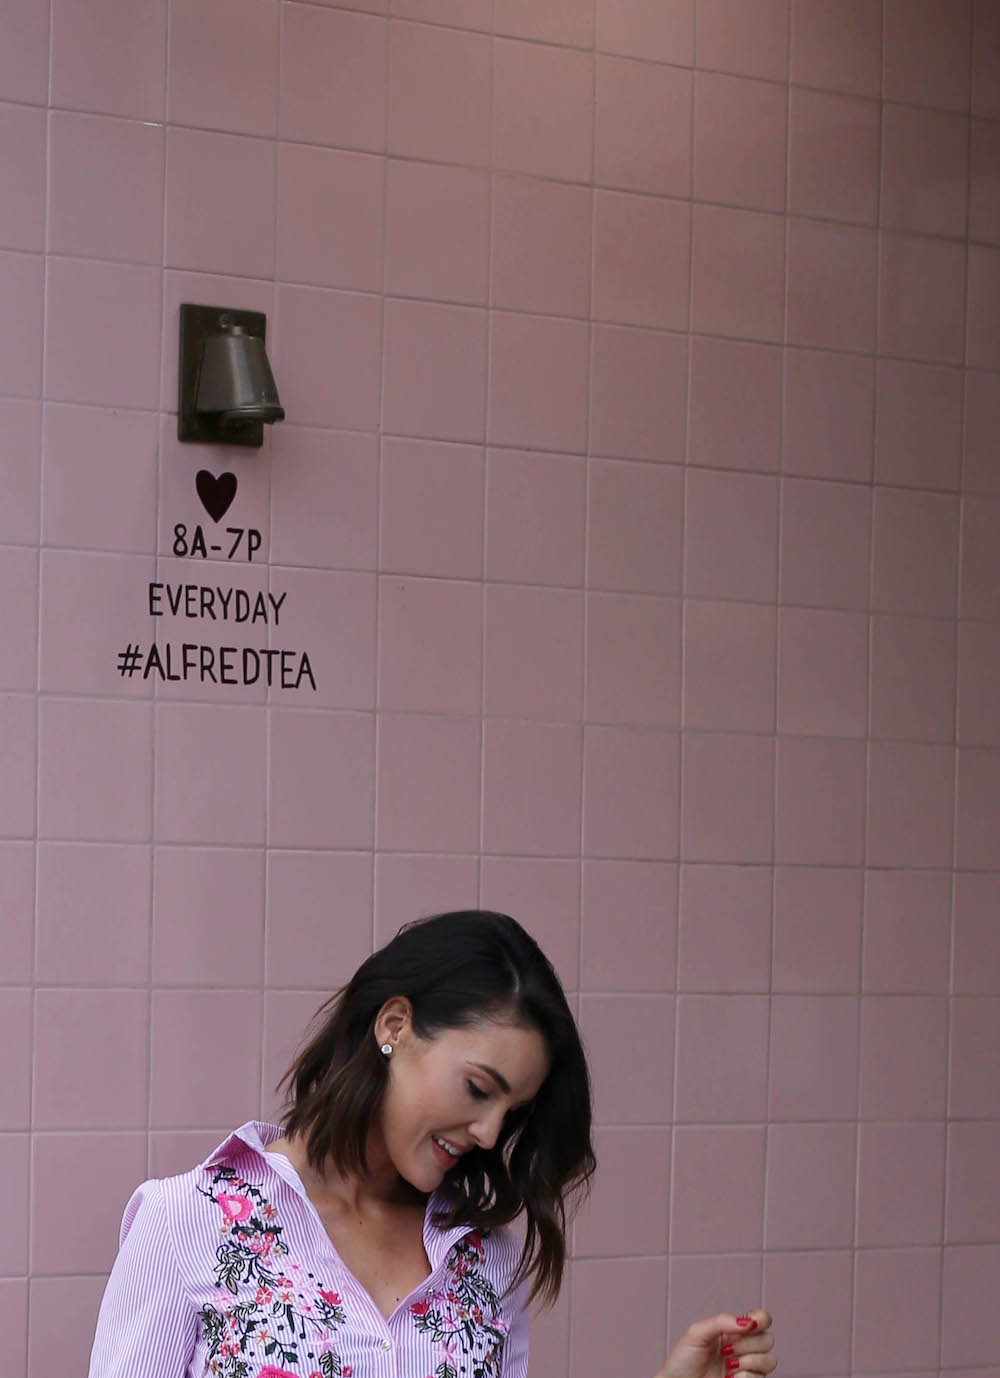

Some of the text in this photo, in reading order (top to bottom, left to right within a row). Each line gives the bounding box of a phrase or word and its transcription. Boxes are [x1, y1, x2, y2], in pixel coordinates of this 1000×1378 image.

[172, 523, 262, 561] 8A-7P
[148, 582, 287, 626] EVERYDAY
[117, 643, 317, 691] #ALFREDTEA
